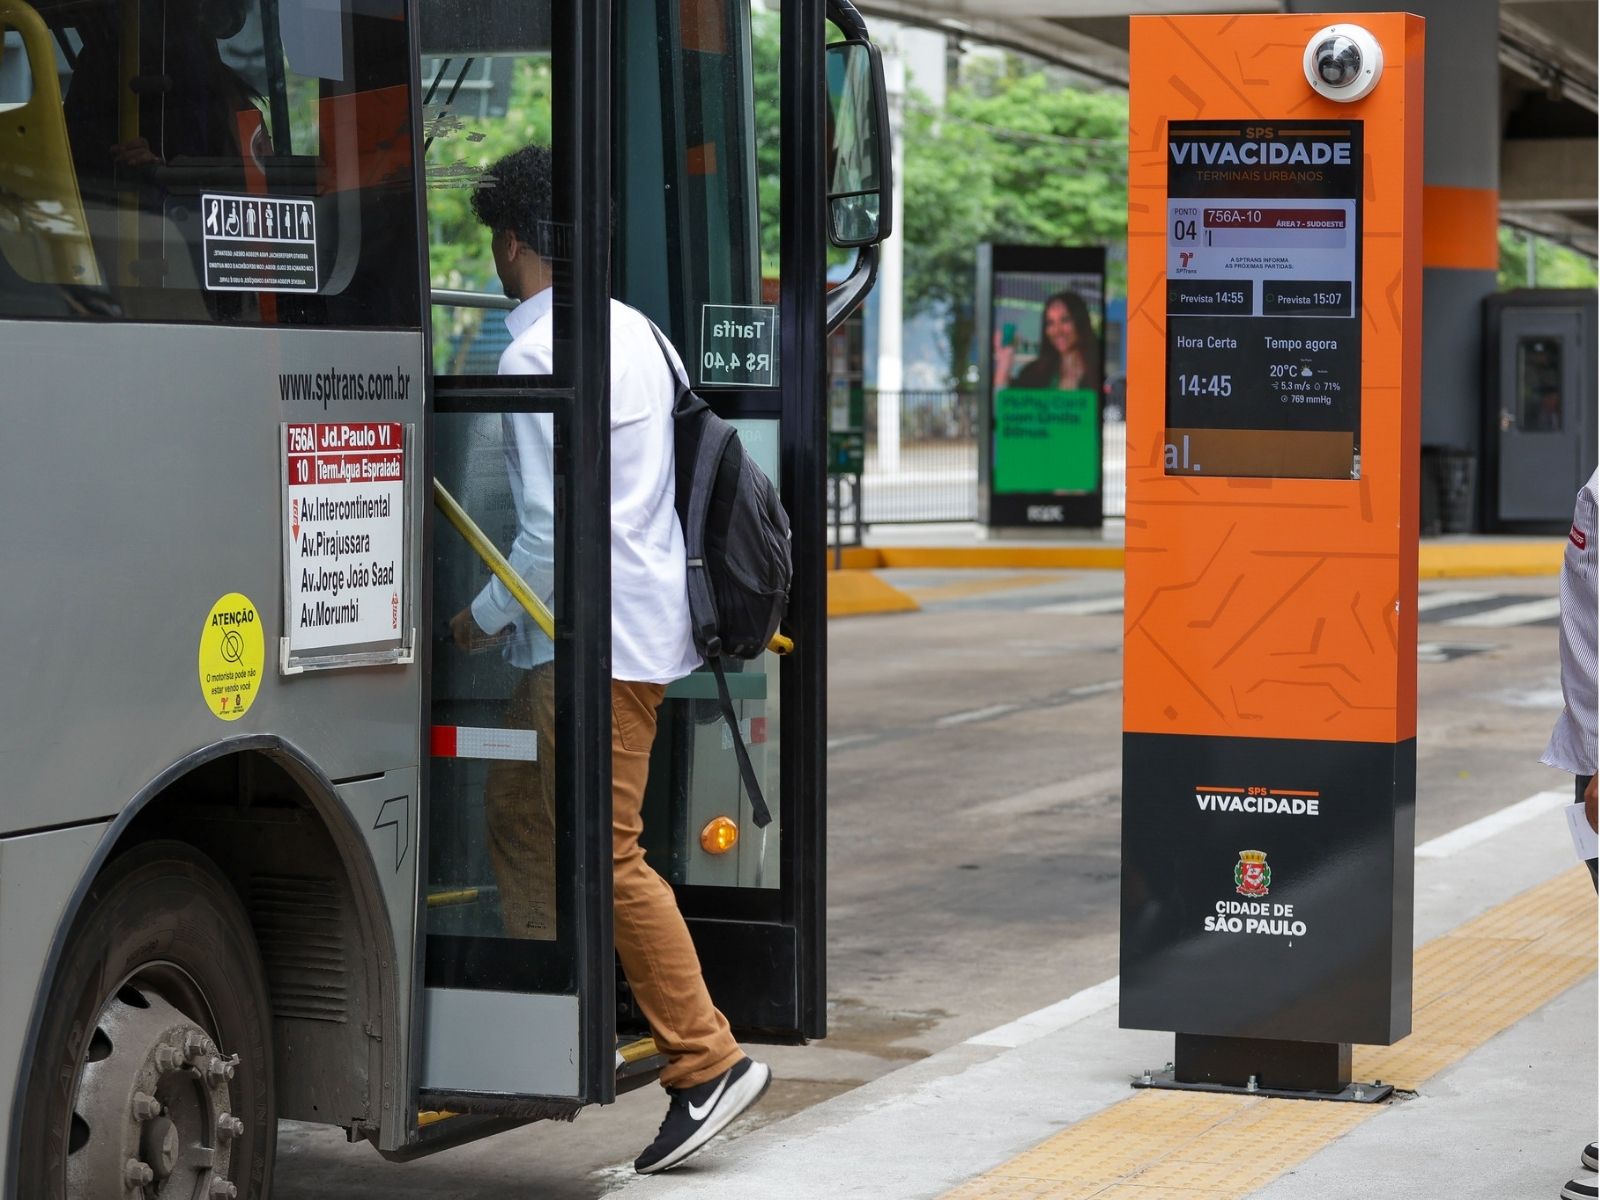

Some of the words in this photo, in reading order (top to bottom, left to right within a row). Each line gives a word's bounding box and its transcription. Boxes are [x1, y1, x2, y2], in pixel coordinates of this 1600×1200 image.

[1246, 127, 1274, 139] SPS
[1169, 142, 1351, 165] VIVACIDADE
[1197, 171, 1260, 181] TERMINAIS
[1264, 171, 1324, 181] URBANOS
[1174, 208, 1198, 216] PONTO
[1207, 210, 1262, 223] 756A-10
[1174, 220, 1198, 241] 04
[1276, 219, 1297, 227] ÁREA
[1180, 294, 1213, 304] Prevista
[1215, 291, 1244, 304] 14:55
[1277, 295, 1311, 304] Prevista
[1313, 293, 1342, 305] 15:07
[1177, 336, 1203, 348] Hora
[1207, 336, 1237, 348] Certa
[1264, 337, 1302, 351] Tempo
[1305, 339, 1337, 351] agora
[1269, 364, 1298, 377] 20°C
[278, 365, 411, 411] www.sptrans.com.br
[1178, 374, 1232, 397] 14:45
[1294, 381, 1311, 391] m/s
[1324, 382, 1341, 391] 71%
[1291, 395, 1305, 403] 769
[1306, 395, 1332, 405] mmHg
[289, 427, 315, 452] 756A
[321, 425, 376, 448] Jd.Paulo
[378, 425, 391, 446] VI
[296, 459, 309, 483] 10
[318, 455, 361, 483] Term.Água
[362, 458, 401, 482] Espraiada
[301, 493, 391, 522] Av.Intercontinental
[301, 530, 371, 562] Av.Pirajussara
[301, 566, 344, 597] Av.Jorge
[346, 562, 369, 590] João
[371, 560, 394, 586] Saad
[212, 607, 254, 627] ATENÇÃO
[300, 598, 359, 628] Av.Morumbi
[206, 673, 211, 683] O
[211, 671, 235, 682] motorista
[235, 669, 247, 680] pode
[247, 668, 257, 678] não
[211, 684, 224, 695] estar
[224, 682, 240, 693] vendo
[240, 681, 251, 691] você
[1248, 786, 1268, 796] SPS
[1196, 794, 1319, 816] VIVACIDADE
[1215, 900, 1270, 916] CIDADE
[1273, 904, 1294, 917] DE
[1204, 913, 1243, 933] SÃO
[1246, 918, 1307, 936] PAULO
